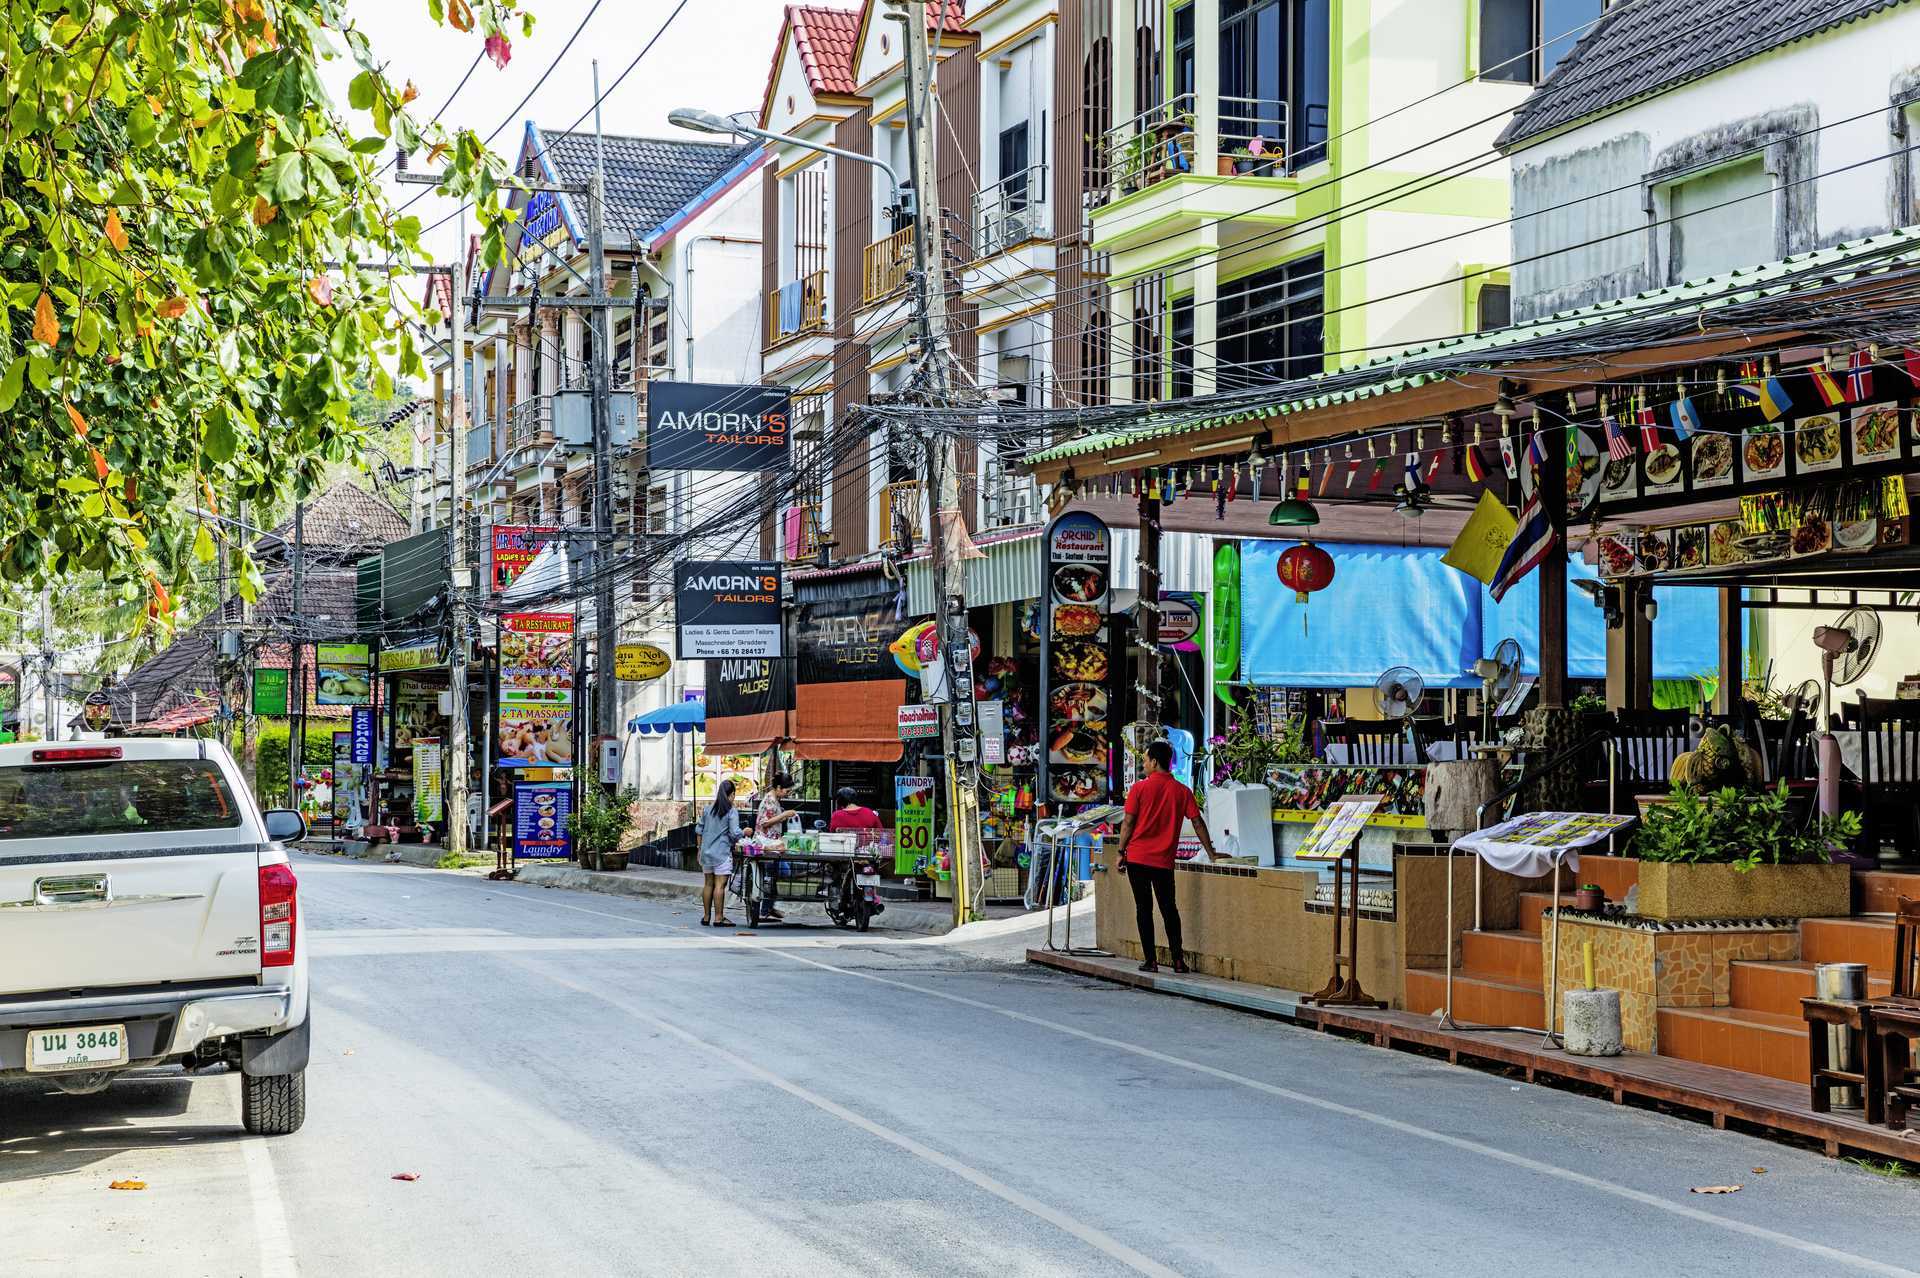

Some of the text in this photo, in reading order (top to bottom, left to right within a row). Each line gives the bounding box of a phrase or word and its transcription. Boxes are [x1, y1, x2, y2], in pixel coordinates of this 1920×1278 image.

[657, 411, 786, 433] AMORN'S
[704, 433, 785, 446] TAILORS
[1061, 529, 1096, 541] ORCHID
[1056, 542, 1104, 551] Restaurant
[683, 575, 777, 592] AMORN'S
[713, 594, 776, 603] TAILORS
[526, 619, 571, 631] RESTAURANT
[684, 628, 704, 636] Ladies
[705, 628, 712, 636] &
[712, 629, 731, 637] Gents
[639, 649, 662, 661] Noi
[738, 679, 769, 695] TAILORS
[509, 709, 523, 718] TA
[525, 709, 570, 719] MASSAGE
[356, 710, 370, 763] EXCHANGE
[896, 777, 933, 787] LAUNDRY
[900, 825, 929, 849] 80
[523, 844, 563, 855] Laundry
[42, 1031, 119, 1052] บน 3848
